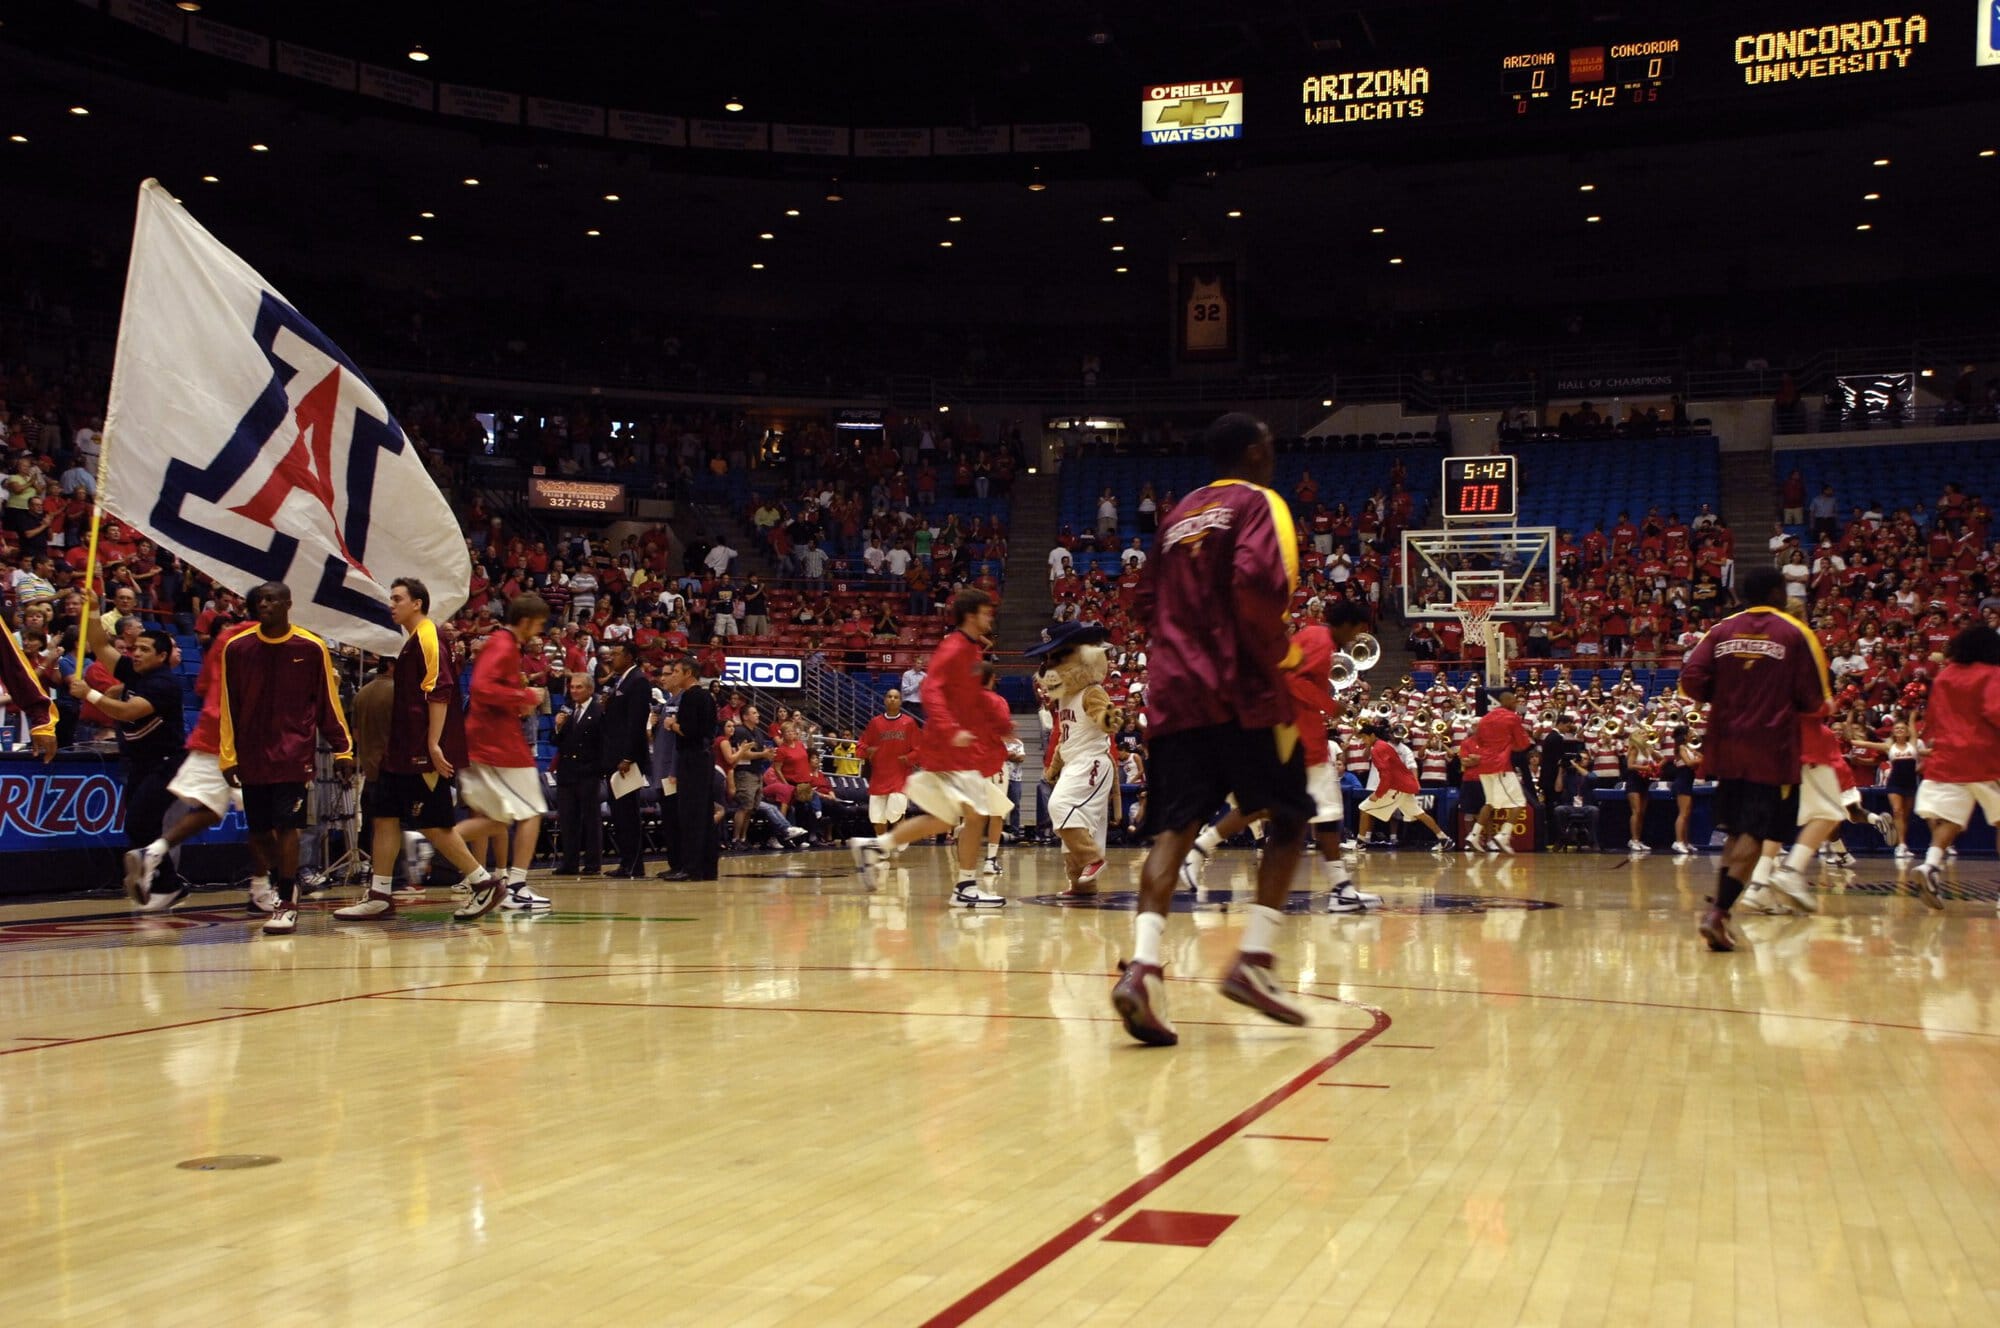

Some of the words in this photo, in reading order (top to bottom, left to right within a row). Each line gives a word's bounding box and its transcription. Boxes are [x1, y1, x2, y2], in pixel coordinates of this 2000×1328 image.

[1610, 39, 1679, 58] CONCORDIA
[1735, 15, 1927, 64] CONCORDIA
[1503, 52, 1555, 69] ARIZONA
[1648, 58, 1662, 78] 0
[1745, 48, 1912, 84] UNIVERSITY
[1302, 67, 1430, 103] ARIZONA
[1531, 70, 1544, 90] 0
[1151, 81, 1234, 99] O'RIELLY
[1570, 86, 1616, 109] 5:42
[1304, 99, 1424, 125] WILDCATS
[1151, 125, 1234, 143] WATSON
[1194, 303, 1220, 321] 32
[1558, 379, 1585, 390] HALL
[1607, 375, 1672, 387] CHAMPIONS
[1464, 462, 1507, 479] 5:42
[550, 498, 606, 509] 327-7463
[1460, 485, 1498, 511] 00
[882, 654, 892, 663] 19
